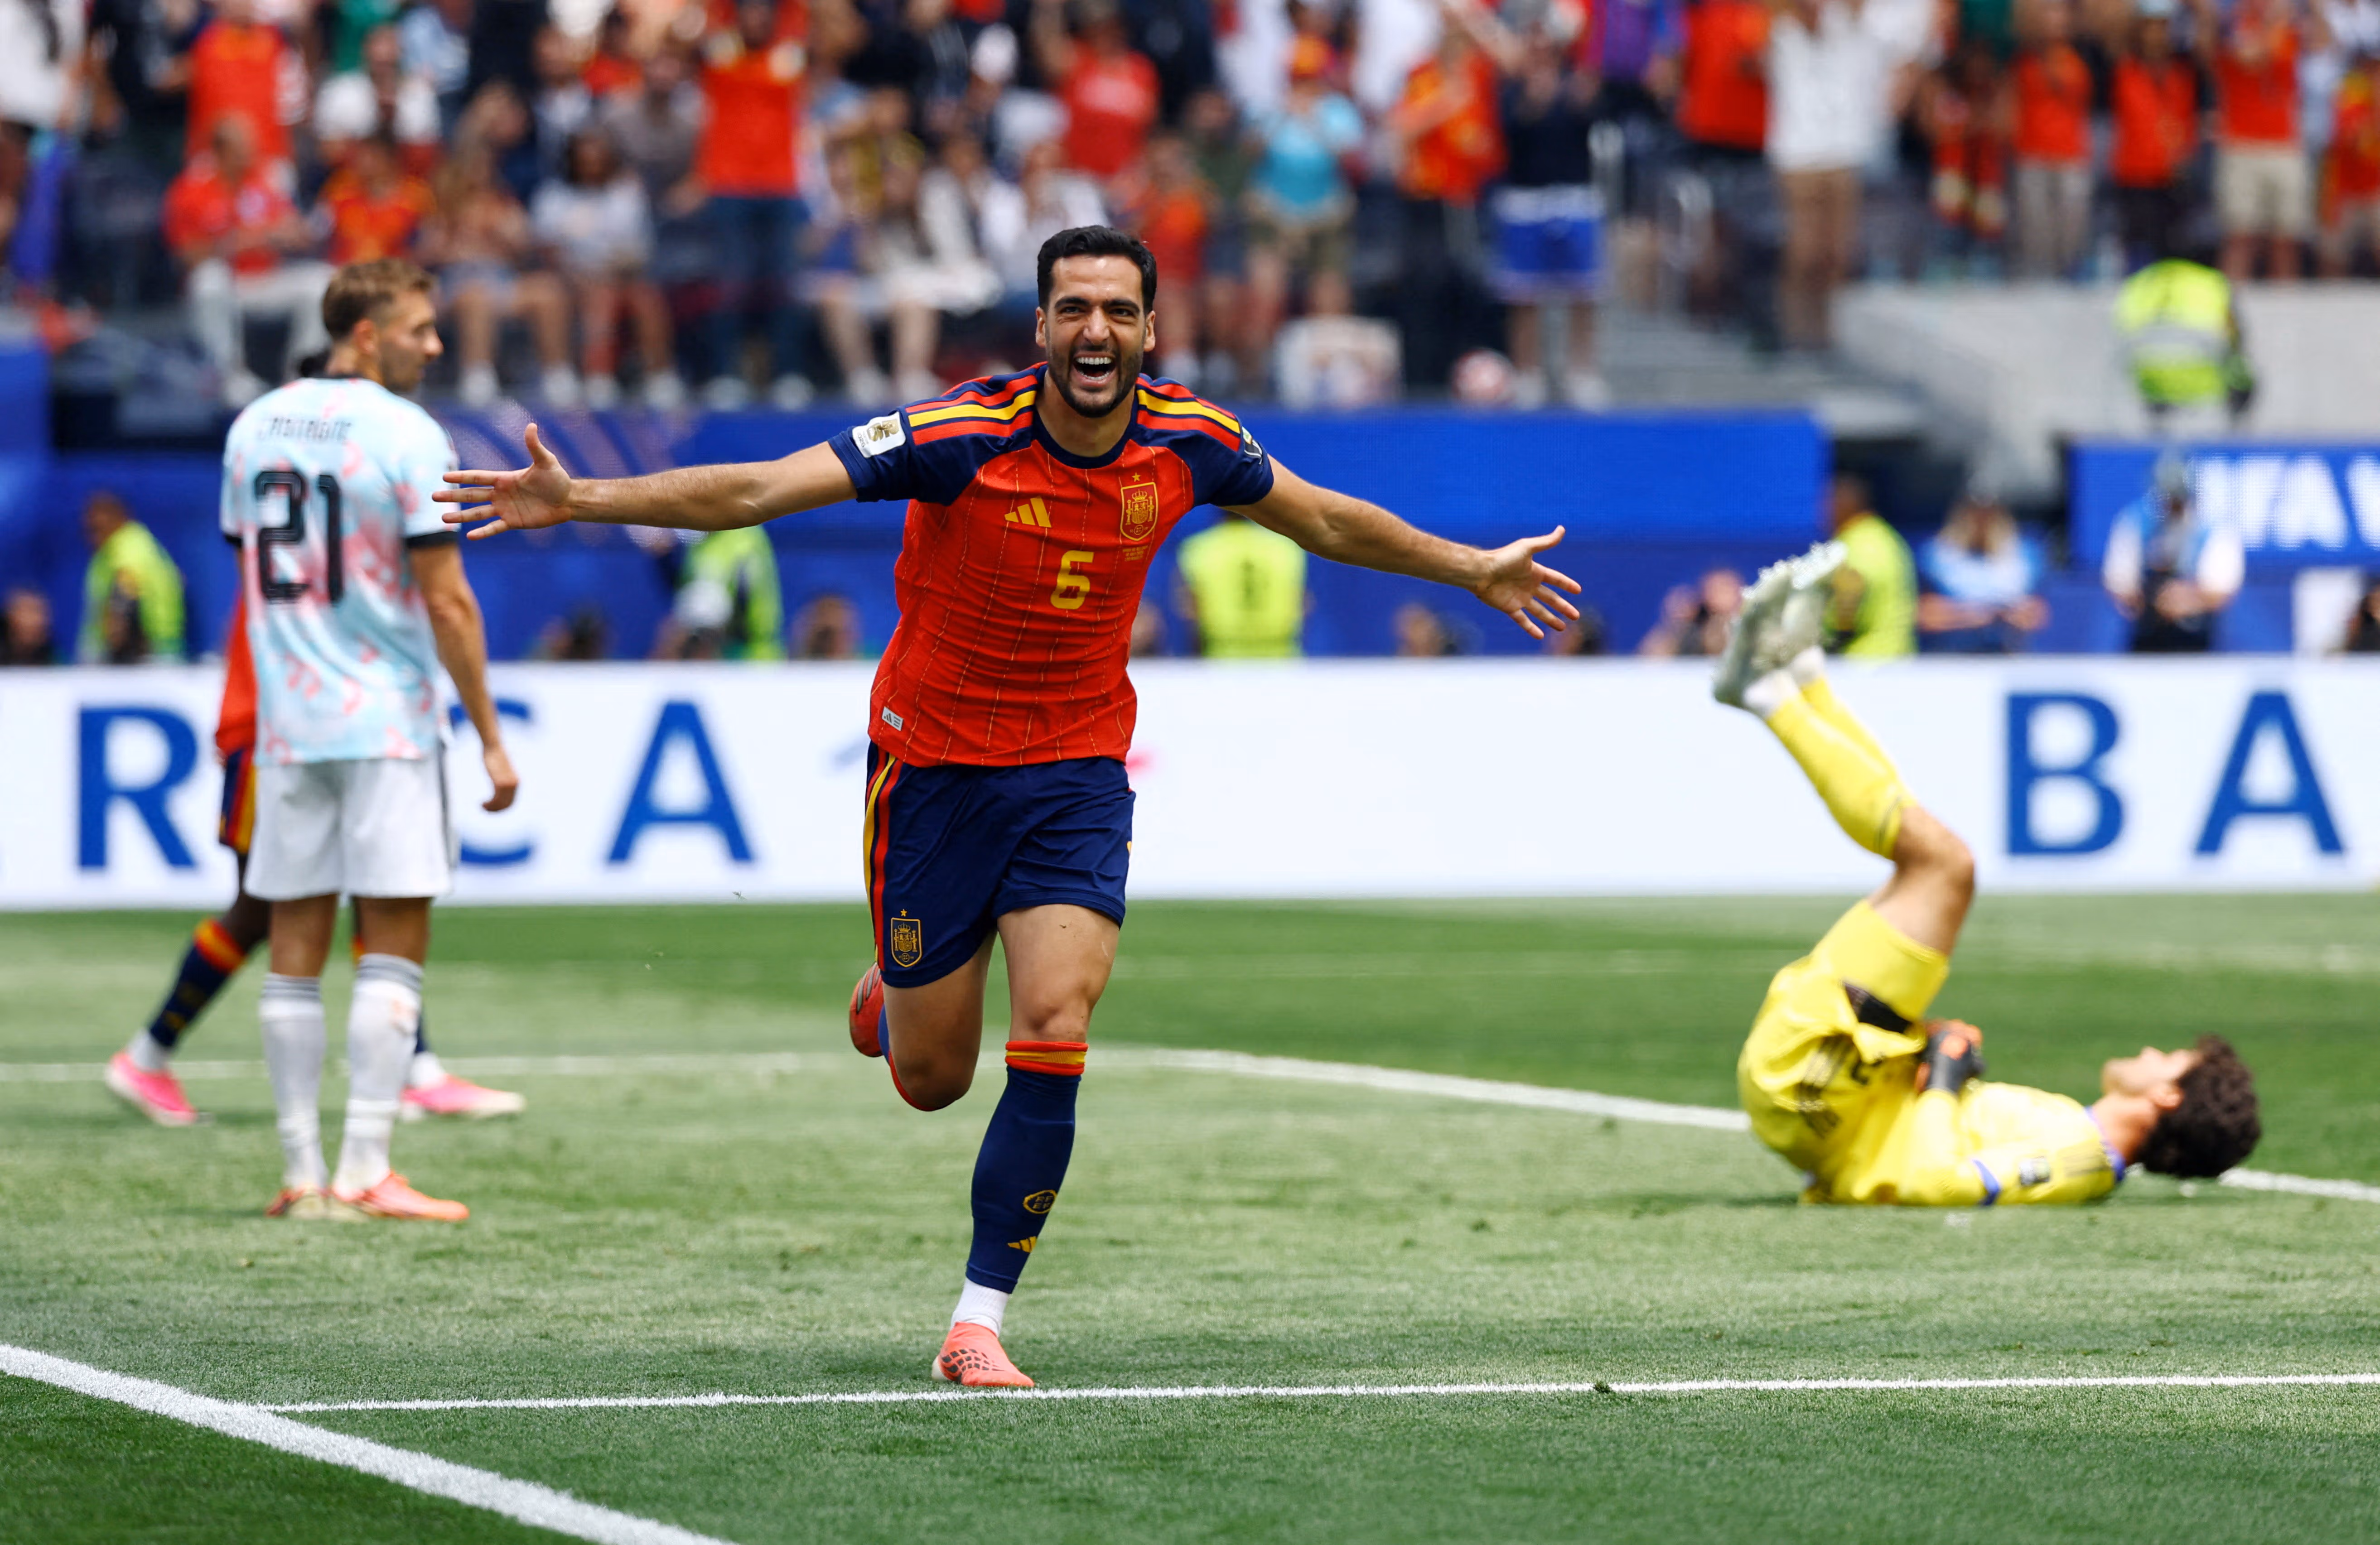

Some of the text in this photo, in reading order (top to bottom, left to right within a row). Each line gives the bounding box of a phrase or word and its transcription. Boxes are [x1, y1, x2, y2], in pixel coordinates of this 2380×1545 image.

[254, 469, 344, 605] 21
[1051, 550, 1094, 610] 6
[2005, 689, 2346, 857] BA
